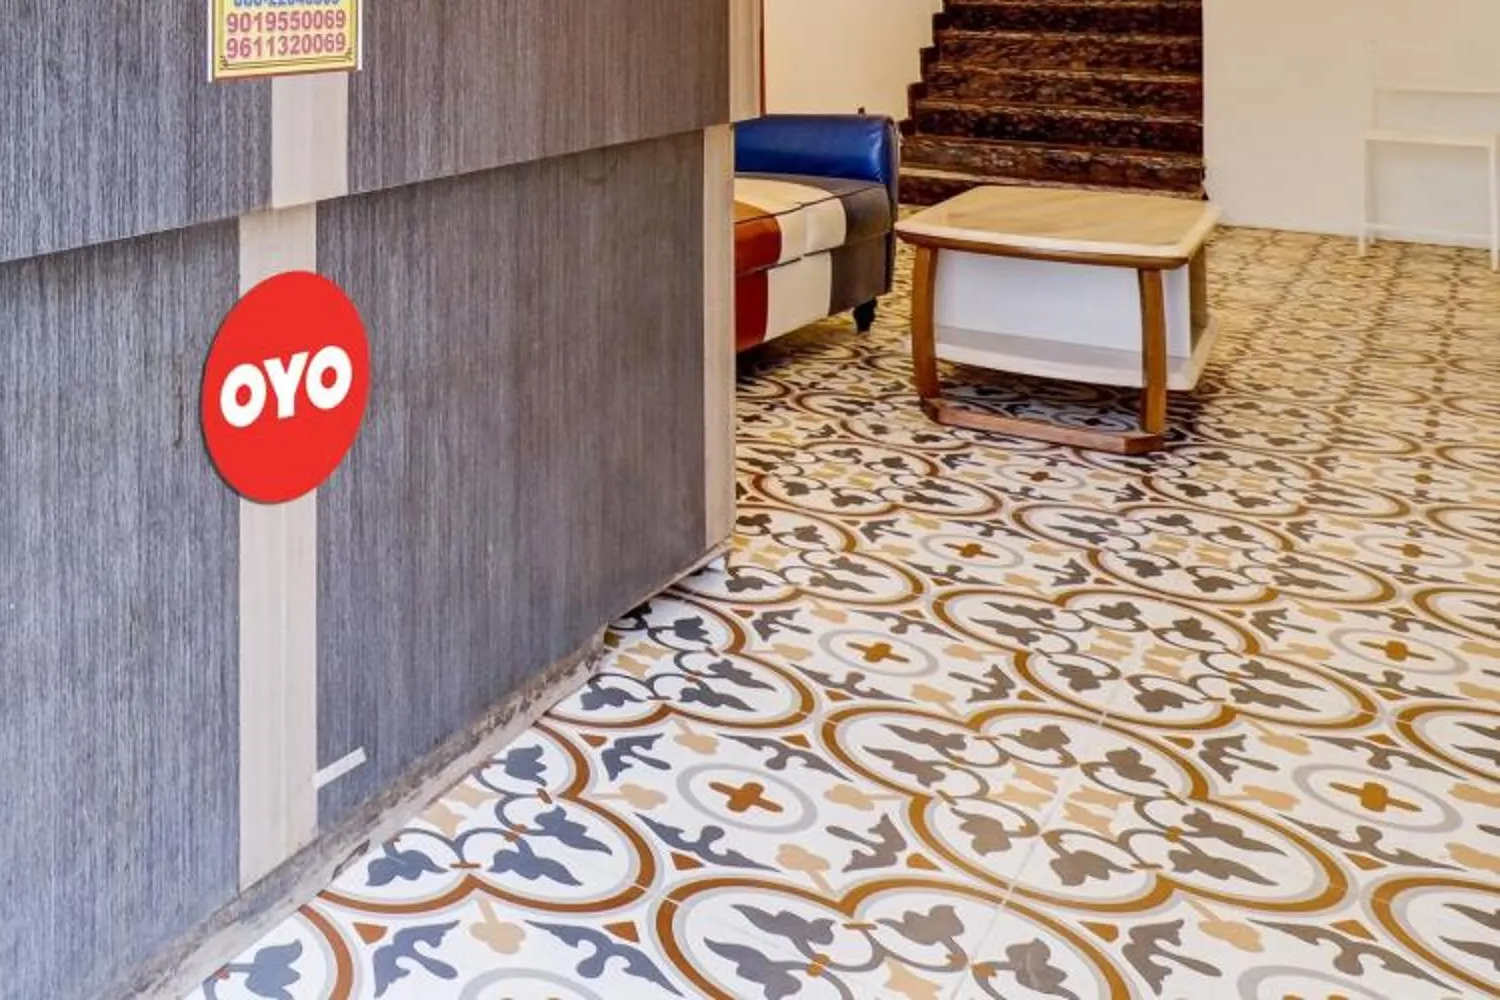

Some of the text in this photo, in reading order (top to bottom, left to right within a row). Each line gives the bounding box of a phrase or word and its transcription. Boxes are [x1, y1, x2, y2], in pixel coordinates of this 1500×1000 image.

[227, 9, 347, 33] 9019550069
[226, 32, 347, 59] 9611320069
[219, 345, 353, 429] OYO
